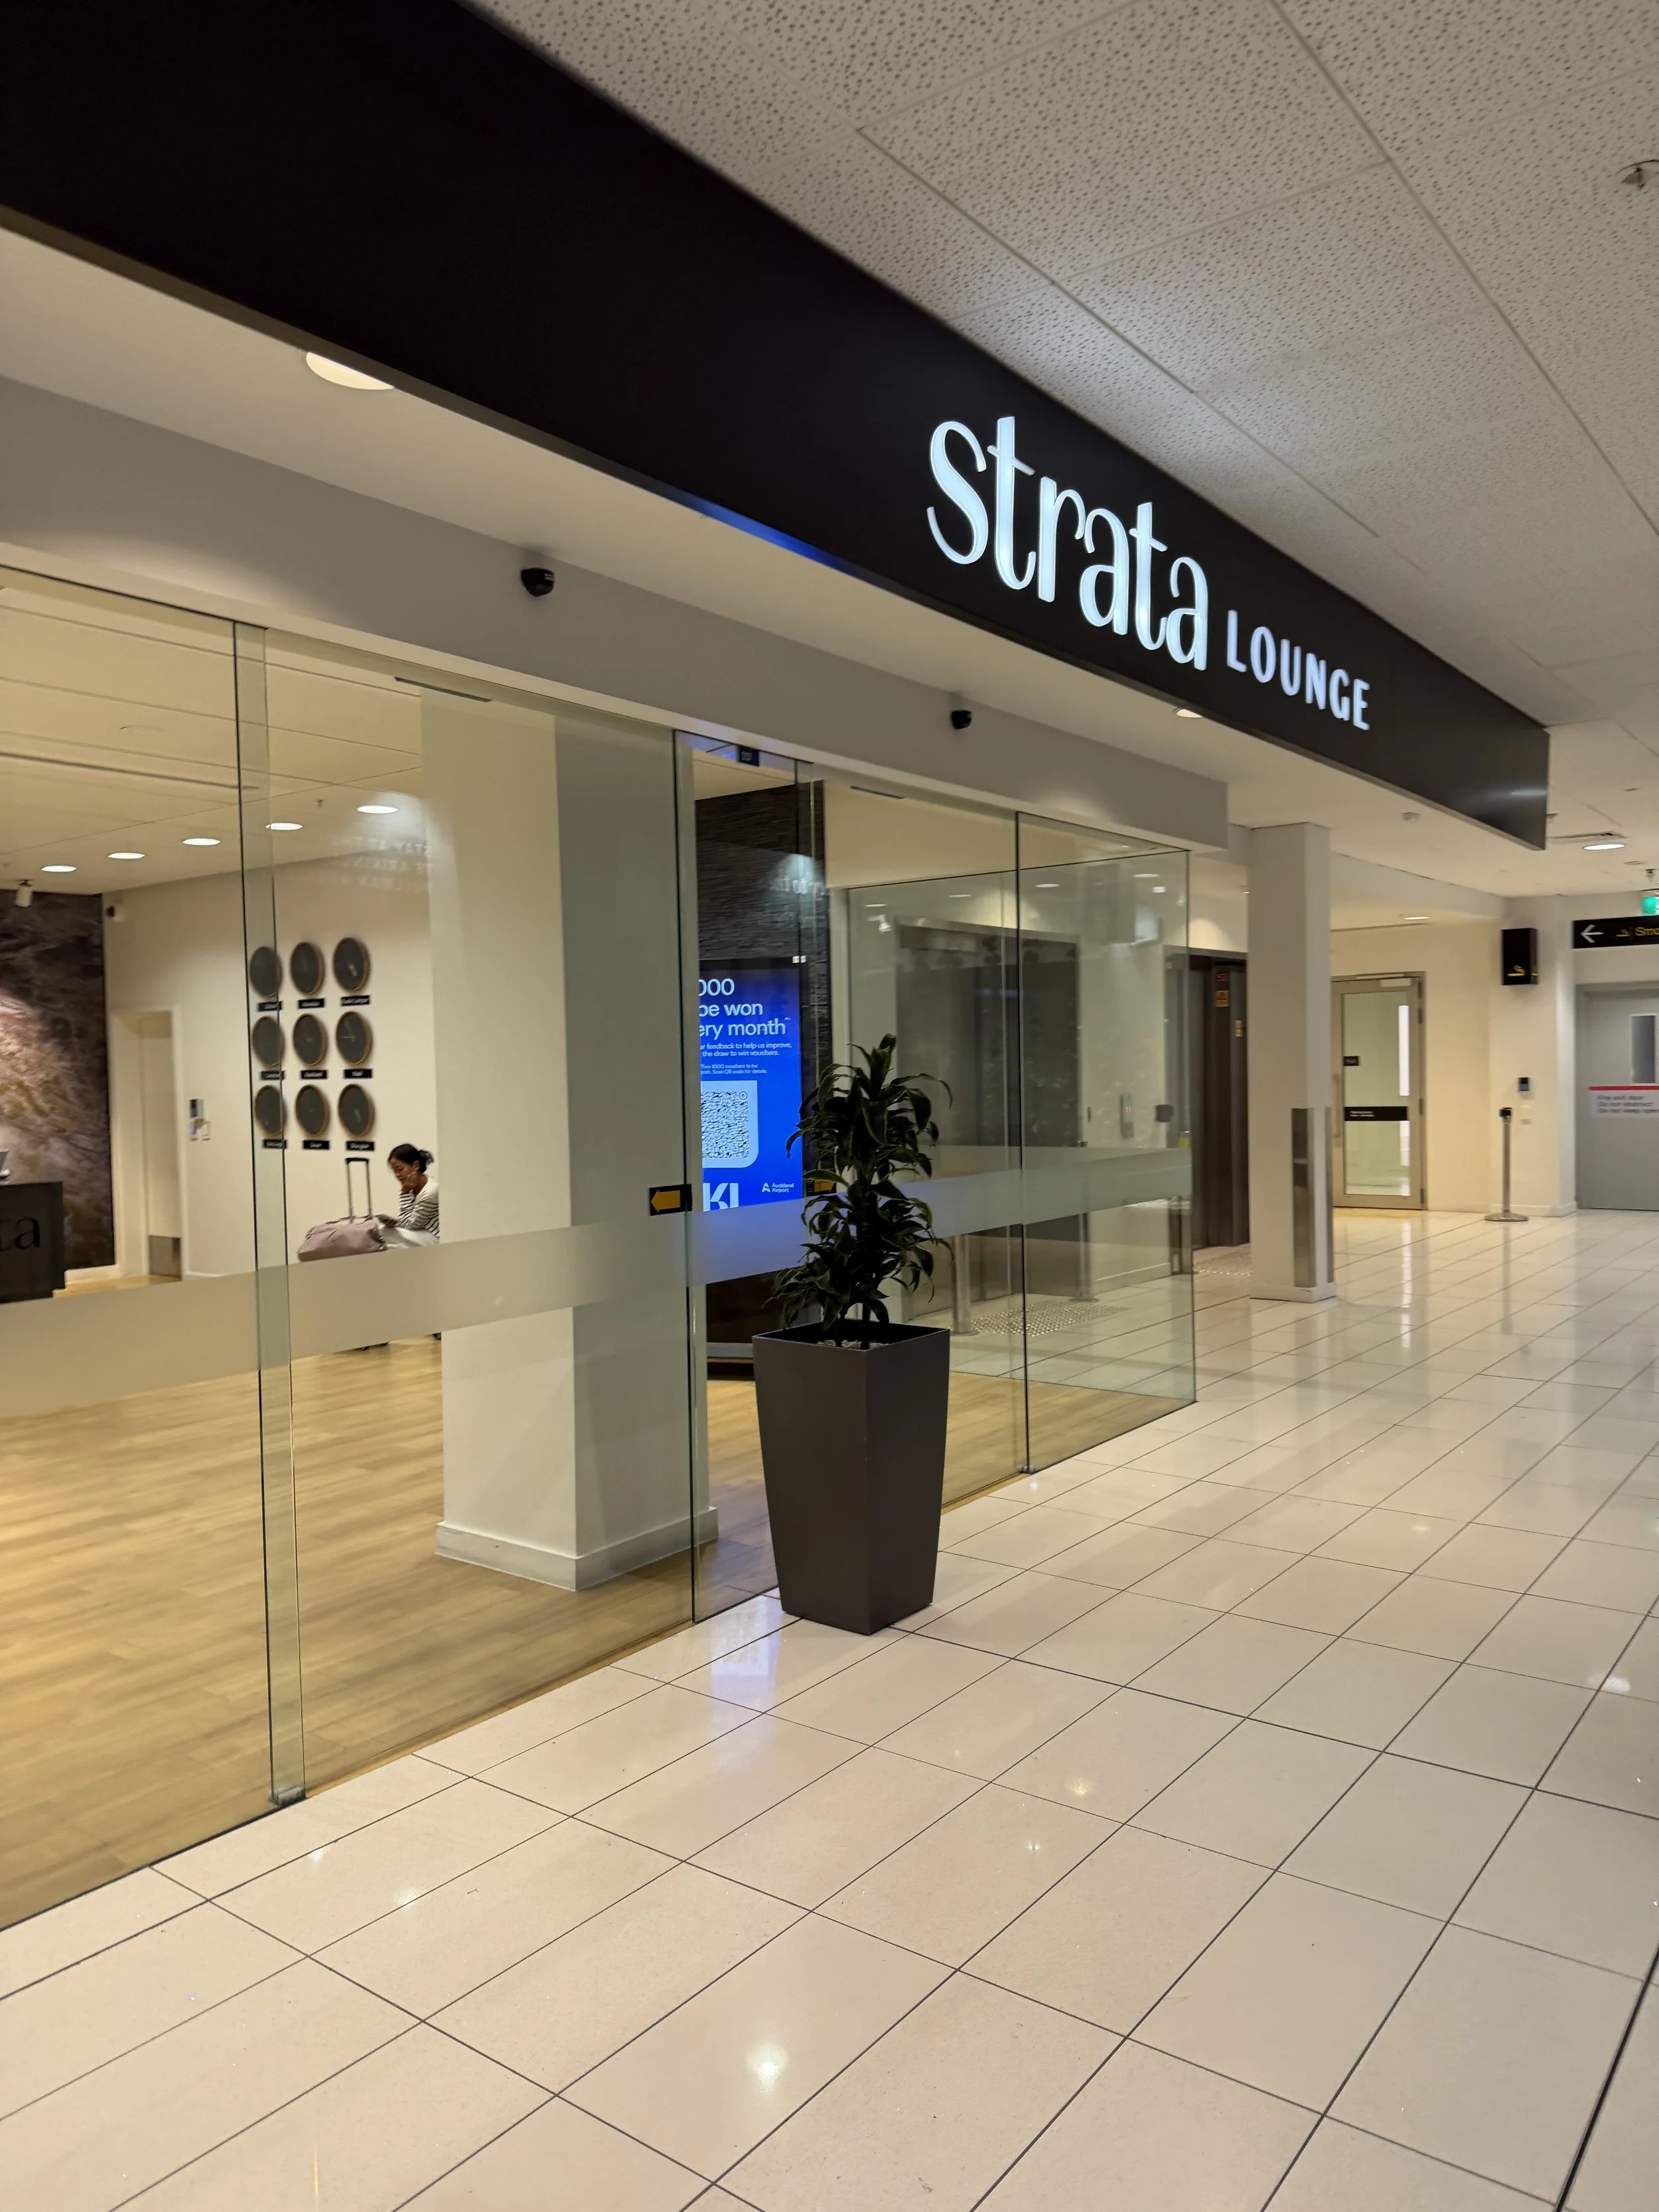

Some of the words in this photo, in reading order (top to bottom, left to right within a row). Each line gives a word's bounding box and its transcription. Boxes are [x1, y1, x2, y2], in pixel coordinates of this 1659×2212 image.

[1226, 609, 1370, 731] LOUNGE
[723, 1003, 763, 1016] won
[728, 1017, 786, 1036] month
